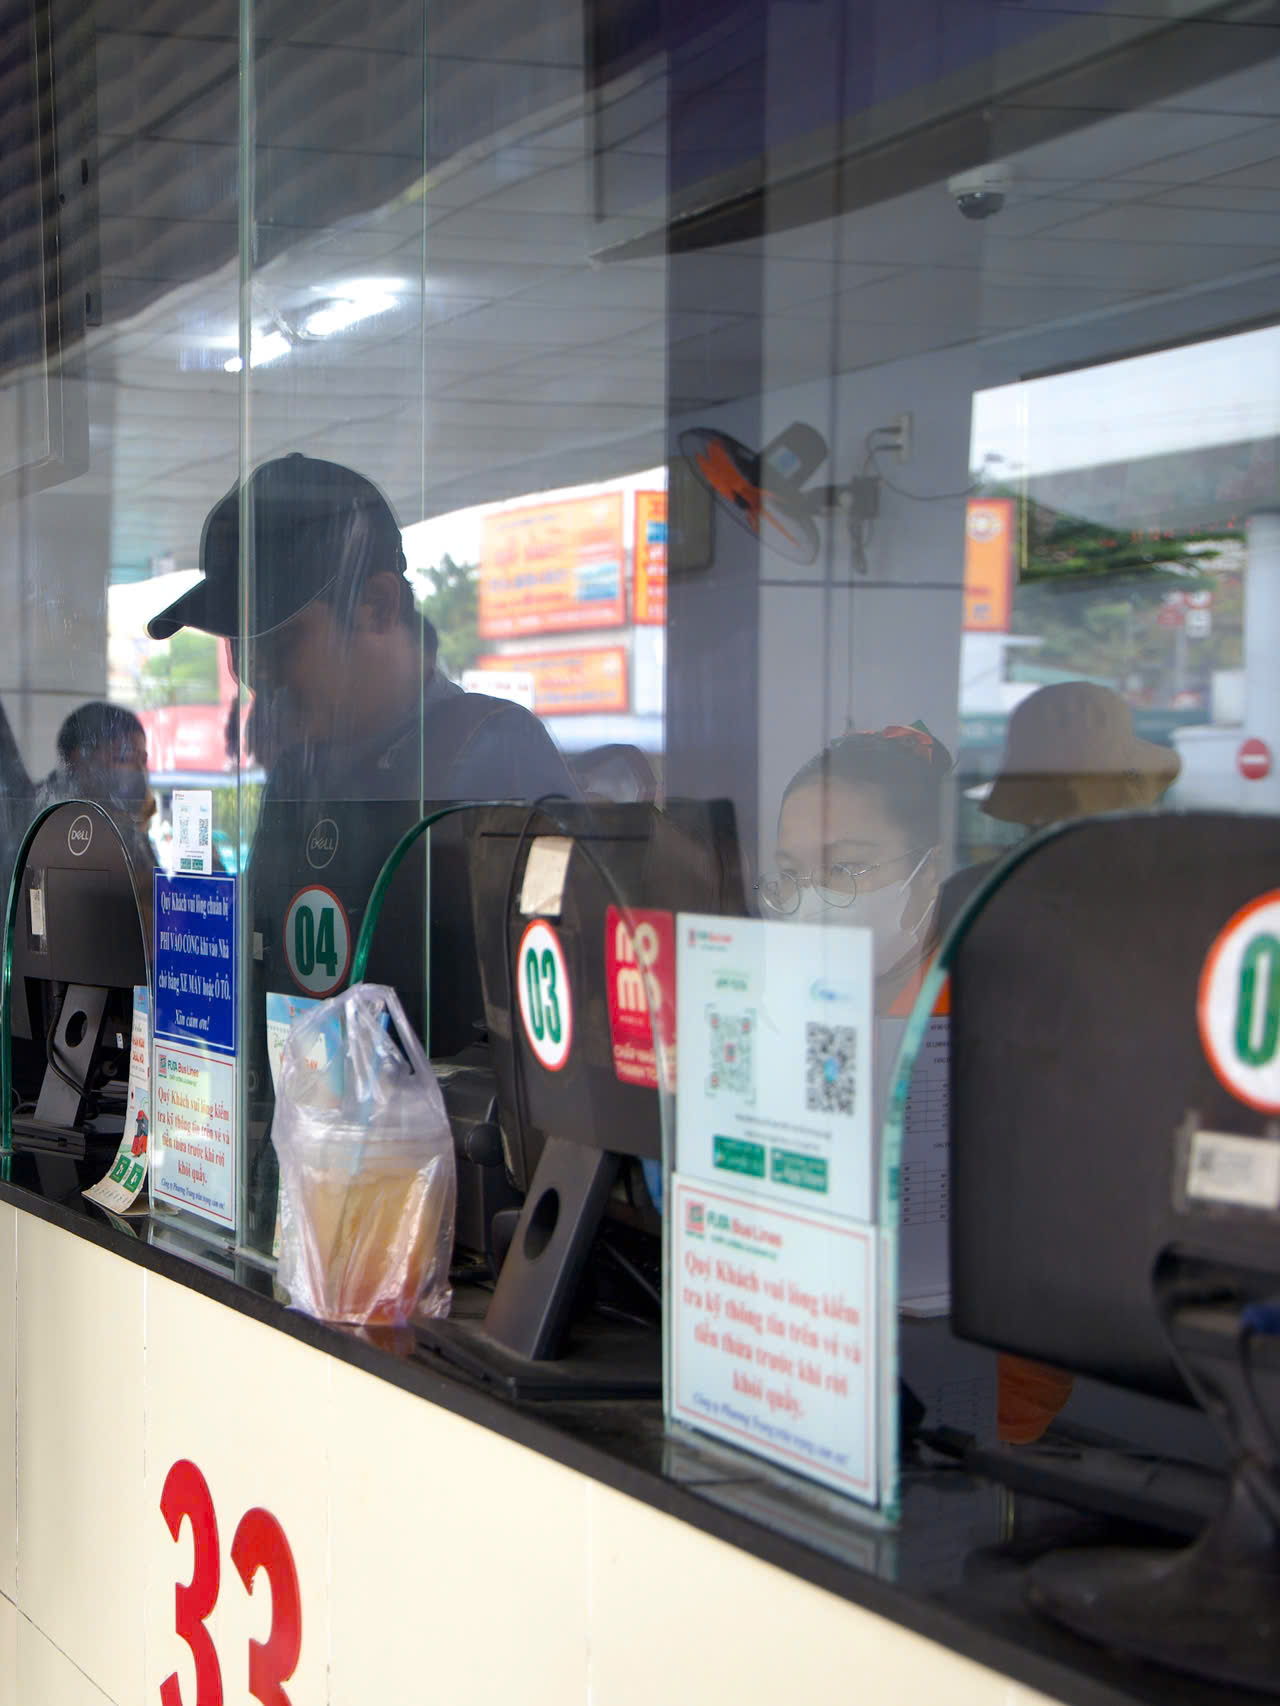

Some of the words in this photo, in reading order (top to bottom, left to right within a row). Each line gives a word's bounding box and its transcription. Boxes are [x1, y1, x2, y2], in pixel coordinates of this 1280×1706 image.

[71, 829, 89, 841] DELL
[310, 835, 335, 852] DELL
[160, 890, 171, 915] Quý
[171, 892, 187, 912] Khách
[187, 893, 195, 913] vui
[160, 925, 170, 951] PHÍ
[170, 926, 182, 953] VÀO
[200, 936, 209, 956] khi
[208, 936, 218, 957] vào
[294, 904, 338, 977] 04
[180, 972, 188, 993] XE
[188, 969, 203, 995] MÁY
[202, 976, 215, 1003] hoặc
[214, 971, 221, 999] Ô
[526, 947, 562, 1044] 03
[175, 1008, 186, 1026] Xin
[178, 1062, 187, 1074] Bus
[157, 1086, 170, 1106] Quý
[171, 1088, 190, 1109] Khách
[159, 1457, 303, 1706] 33
